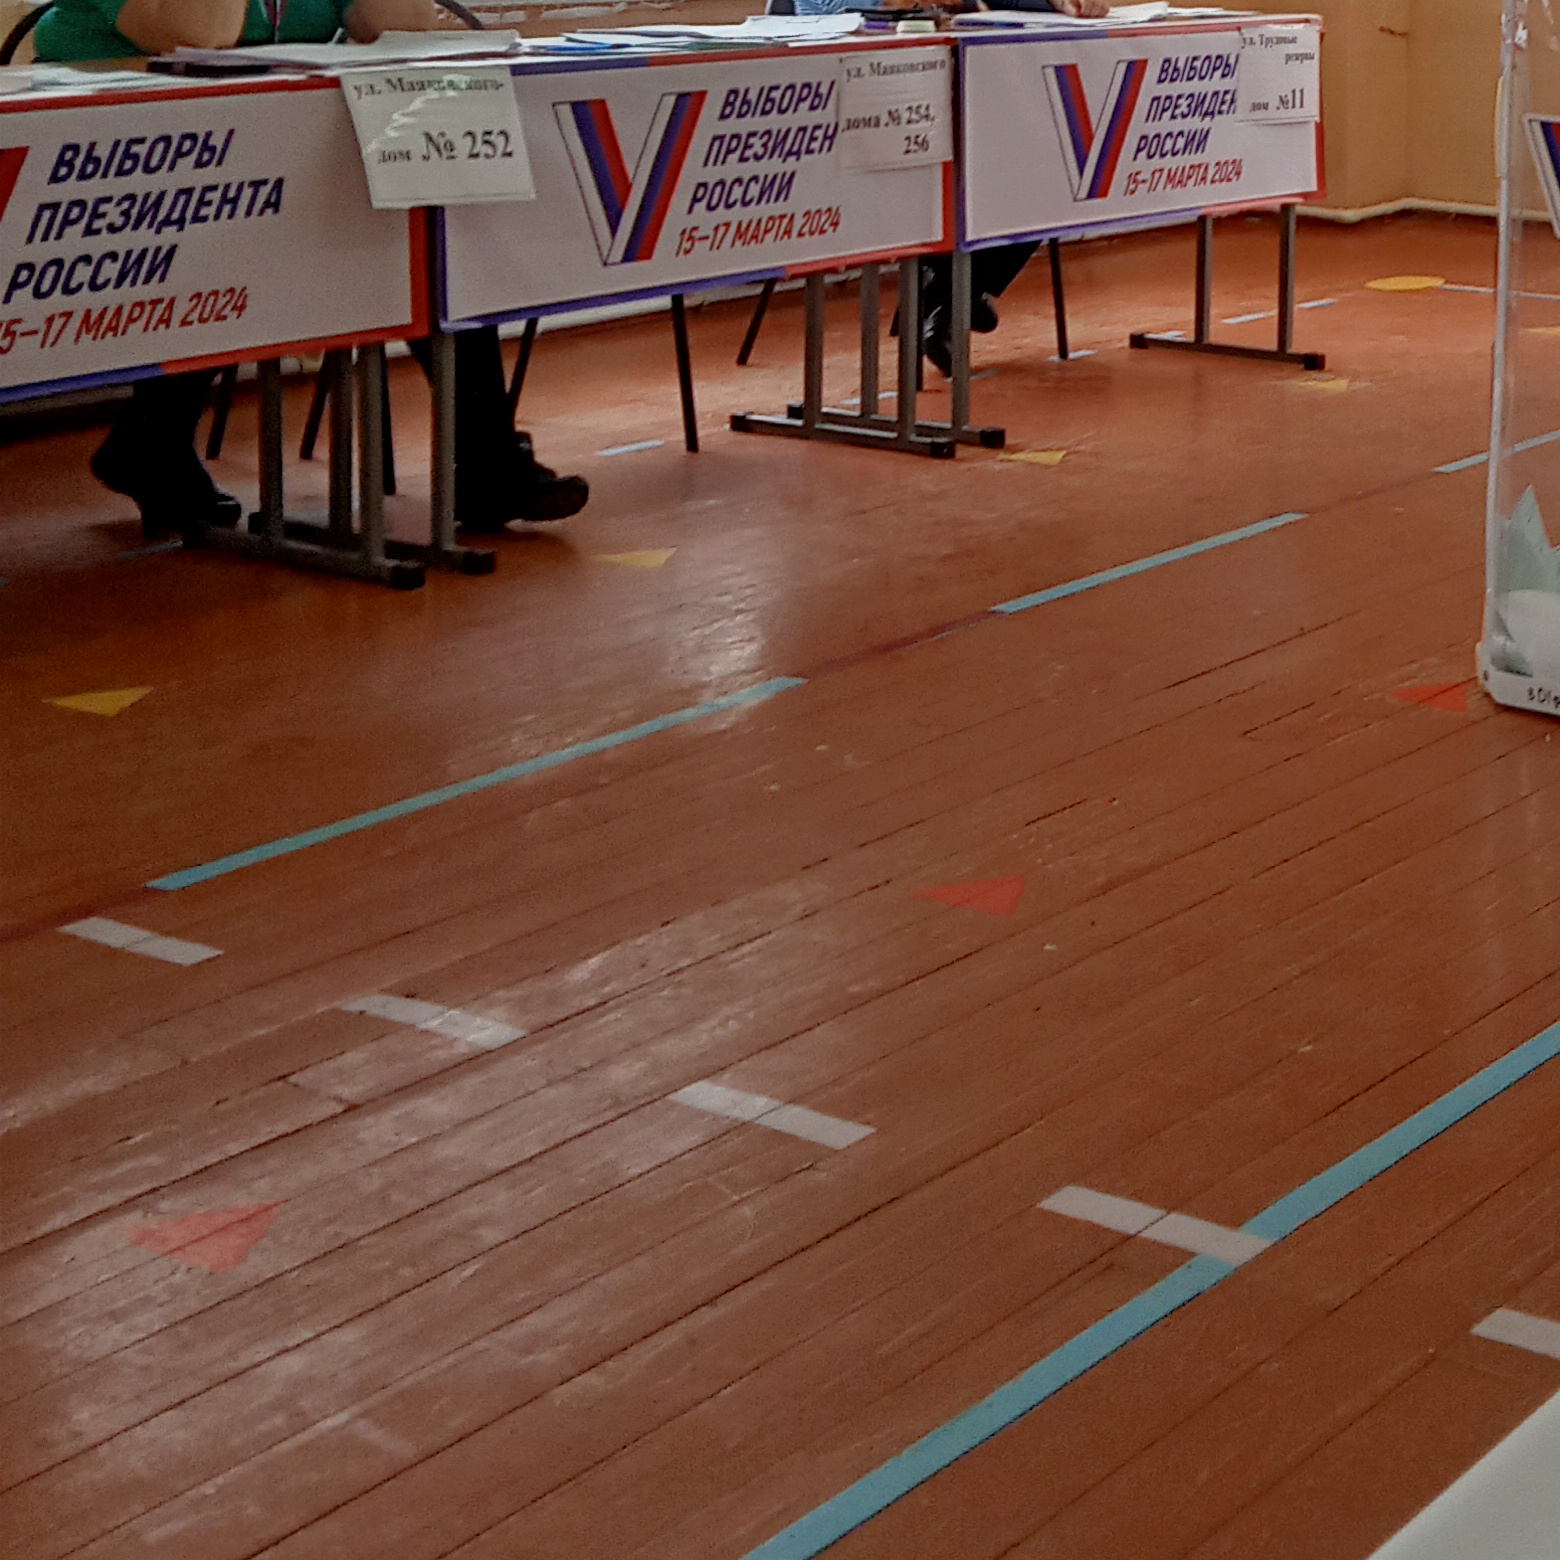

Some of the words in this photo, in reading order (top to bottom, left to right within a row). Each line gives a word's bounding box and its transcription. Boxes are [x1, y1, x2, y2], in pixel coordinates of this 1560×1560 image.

[1156, 52, 1240, 86] ВЫБОРЫ
[717, 79, 837, 122] ВЫБОРЫ
[1144, 87, 1238, 124] ПРЕЗИДЕН
[1249, 101, 1270, 113] дом
[702, 121, 840, 169] ПРЕЗИДЕН
[841, 115, 882, 133] дома
[903, 134, 931, 156] 256
[1132, 126, 1212, 162] РОССИИ
[47, 128, 236, 186] ВЫБОРЫ
[378, 148, 413, 165] дом
[462, 128, 515, 161] 252
[687, 170, 797, 216] РОССИИ
[1122, 167, 1164, 198] 15-17
[1162, 163, 1210, 193] МАРТА
[1210, 157, 1244, 187] 2024
[25, 176, 285, 247] ПРЕЗИДЕНТА
[674, 222, 729, 259] 15-17
[729, 217, 794, 251] МАРТА
[798, 204, 842, 241] 2024
[2, 243, 178, 305] РОССИИ
[0, 310, 74, 356] 5-17
[73, 295, 177, 346] МАРТА
[177, 285, 249, 329] 2024
